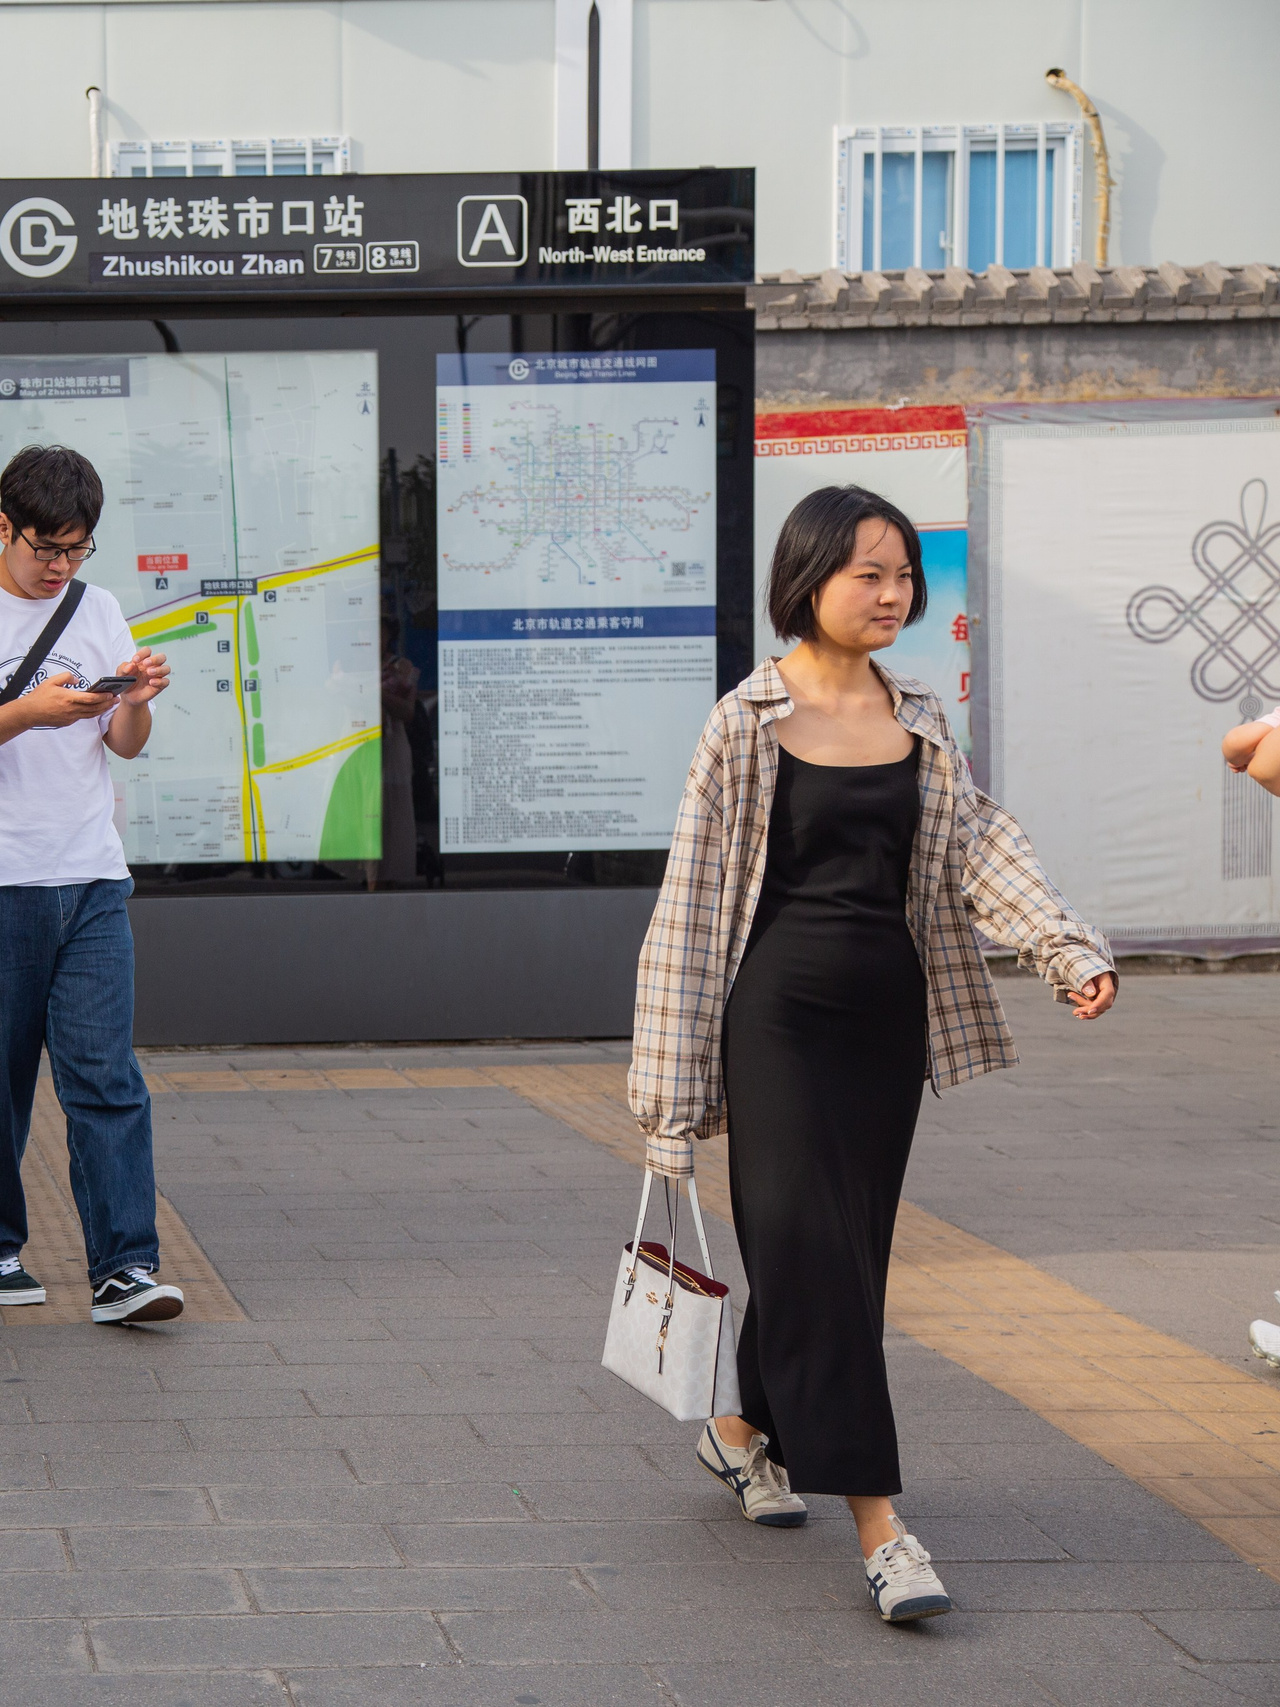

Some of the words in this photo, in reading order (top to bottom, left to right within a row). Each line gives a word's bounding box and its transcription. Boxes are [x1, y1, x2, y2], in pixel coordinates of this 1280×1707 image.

[97, 194, 365, 240] 地铁珠市口站
[565, 196, 679, 234] 西北口
[469, 203, 516, 256] A
[538, 246, 634, 264] North-West
[636, 245, 706, 263] Entrance
[102, 254, 234, 277] Zhushikou
[242, 253, 305, 276] Zhan
[535, 356, 658, 370] 北京城市轨道交通线网图
[19, 389, 37, 397] Map
[38, 388, 47, 396] of
[47, 387, 98, 395] Zhushikou
[361, 381, 371, 392] 北
[146, 556, 180, 565] 当前位置
[157, 579, 168, 589] A
[204, 581, 254, 590] 地铁珠市口站
[265, 591, 276, 602] C
[198, 613, 207, 623] D
[512, 616, 644, 631] 北京市轨道交通乘客守则
[219, 641, 228, 652] E
[58, 654, 83, 670] yourself
[218, 680, 229, 691] G
[246, 680, 255, 691] F
